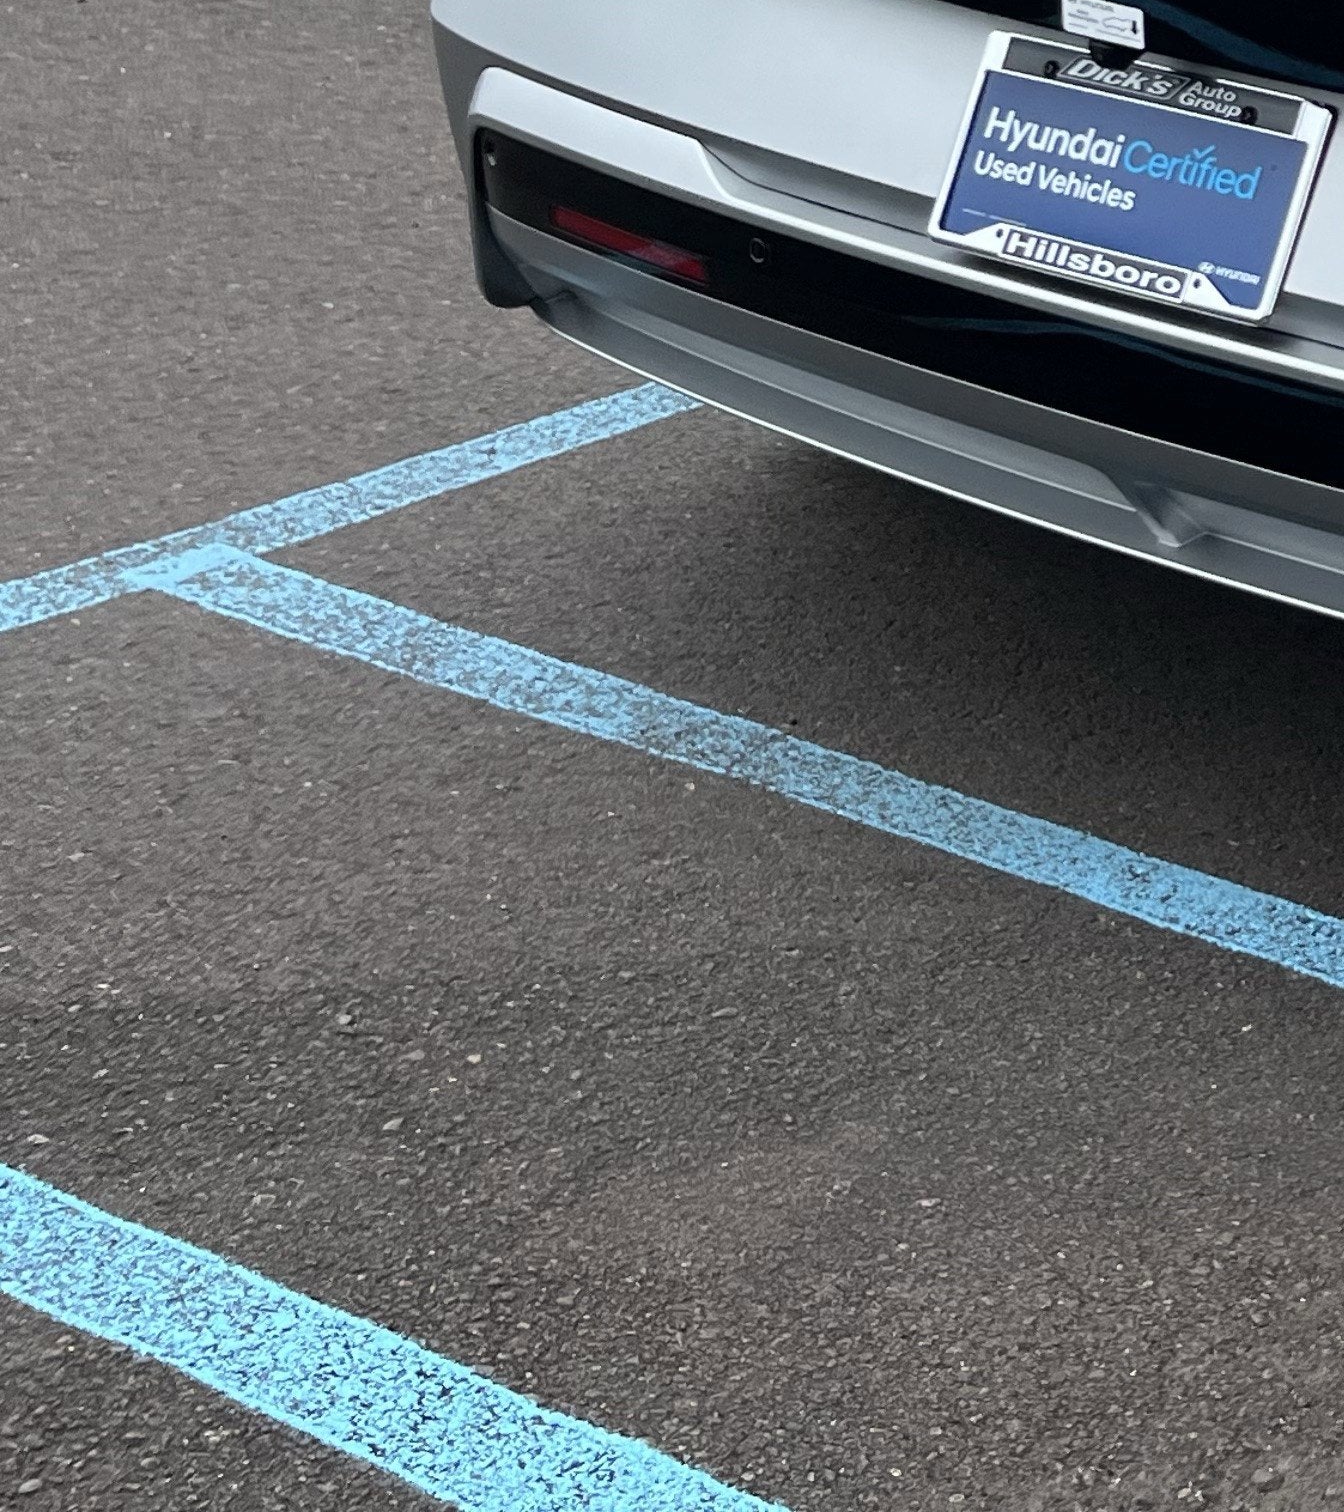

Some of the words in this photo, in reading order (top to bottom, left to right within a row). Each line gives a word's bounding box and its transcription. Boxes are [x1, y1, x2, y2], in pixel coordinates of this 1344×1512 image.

[1178, 92, 1243, 118] Group
[1187, 81, 1237, 103] Auto
[973, 150, 1036, 186] Used
[1038, 165, 1136, 211] Vehicles
[983, 106, 1126, 169] Hyundai
[1123, 139, 1263, 200] Certified
[1005, 231, 1182, 295] Hillsboro
